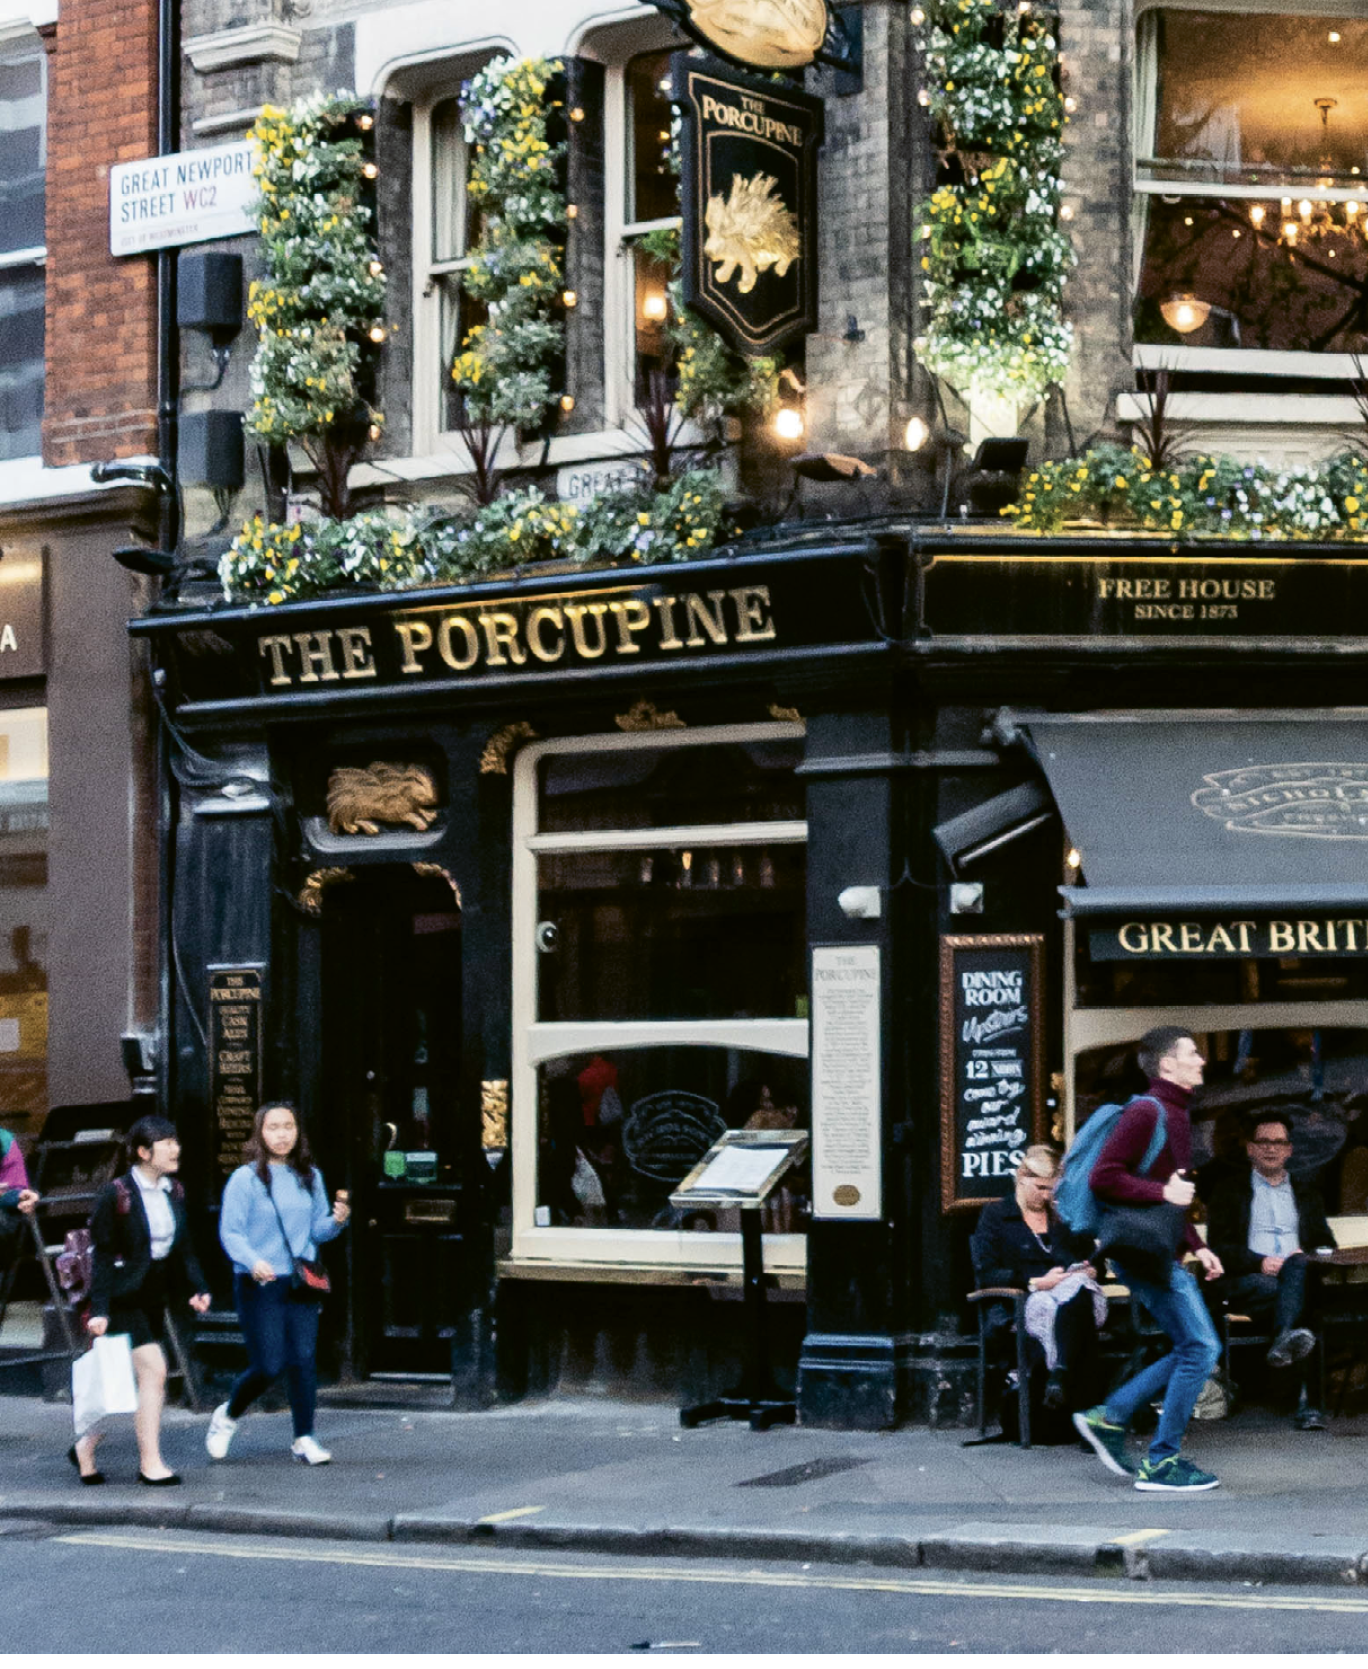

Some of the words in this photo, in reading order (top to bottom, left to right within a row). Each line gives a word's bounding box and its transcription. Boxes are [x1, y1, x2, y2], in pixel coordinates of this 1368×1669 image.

[741, 96, 766, 115] THE
[702, 95, 804, 146] PORCUPINE
[120, 168, 169, 195] GREAT
[177, 150, 254, 185] NEWPORT
[120, 193, 175, 223] STREET
[183, 186, 218, 211] WC2
[1098, 578, 1151, 599] FREE
[1178, 578, 1276, 599] HOUSE
[1134, 604, 1195, 619] SINCE
[258, 627, 378, 685] THE
[395, 584, 776, 674] PORCUPINE
[1118, 921, 1257, 953] GREAT
[814, 968, 877, 981] PORCUPINE
[961, 971, 1023, 989] DINING
[965, 987, 1021, 1006] ROOM
[965, 1060, 989, 1079] 12
[961, 1149, 1028, 1179] PIES
